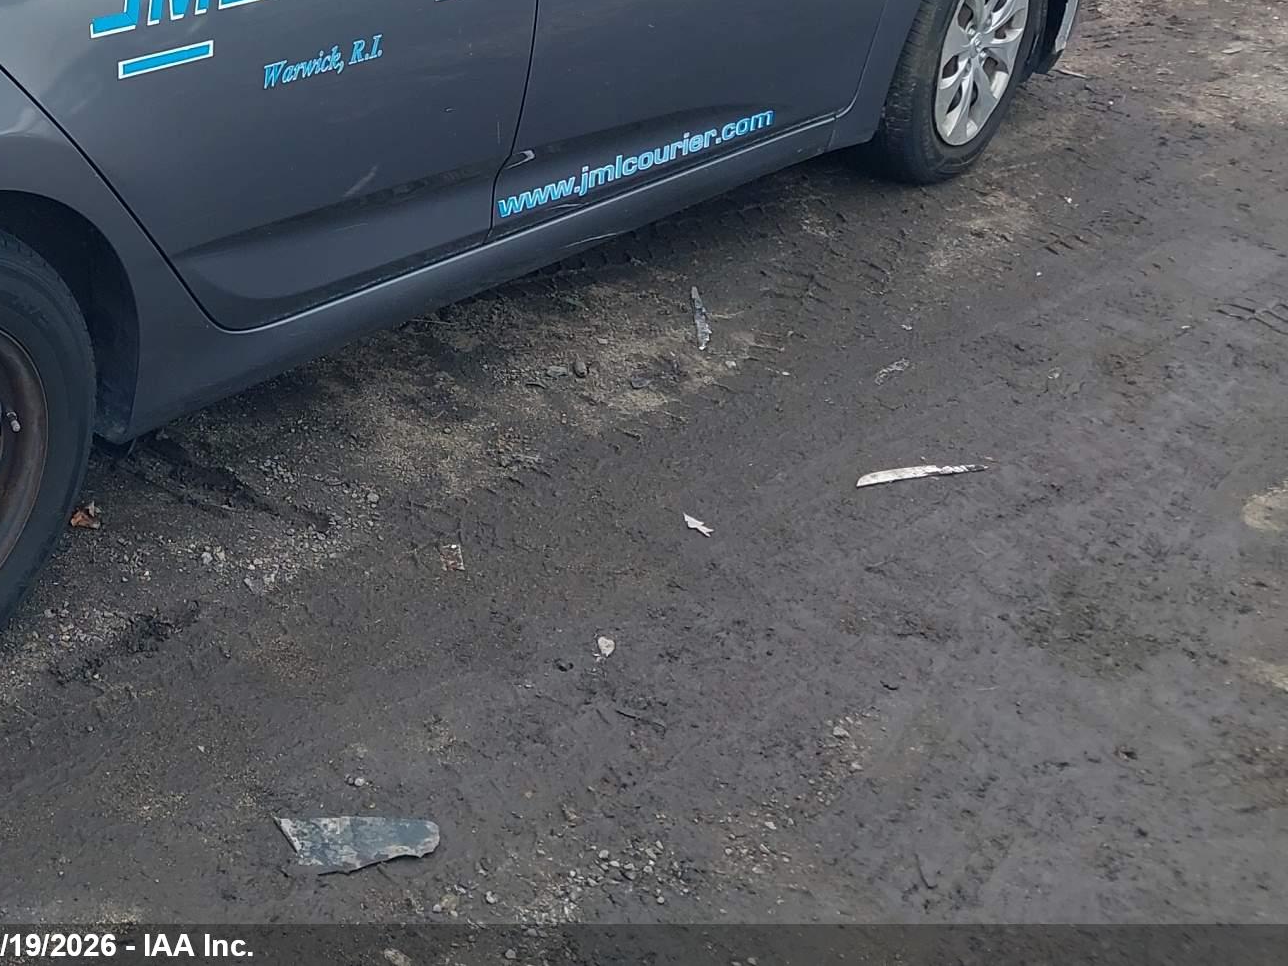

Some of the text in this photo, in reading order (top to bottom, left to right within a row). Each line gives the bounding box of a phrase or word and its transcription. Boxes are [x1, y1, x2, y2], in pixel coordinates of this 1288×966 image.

[263, 34, 383, 90] Warwick, R.I.
[497, 109, 774, 218] www.jmlcourier.com
